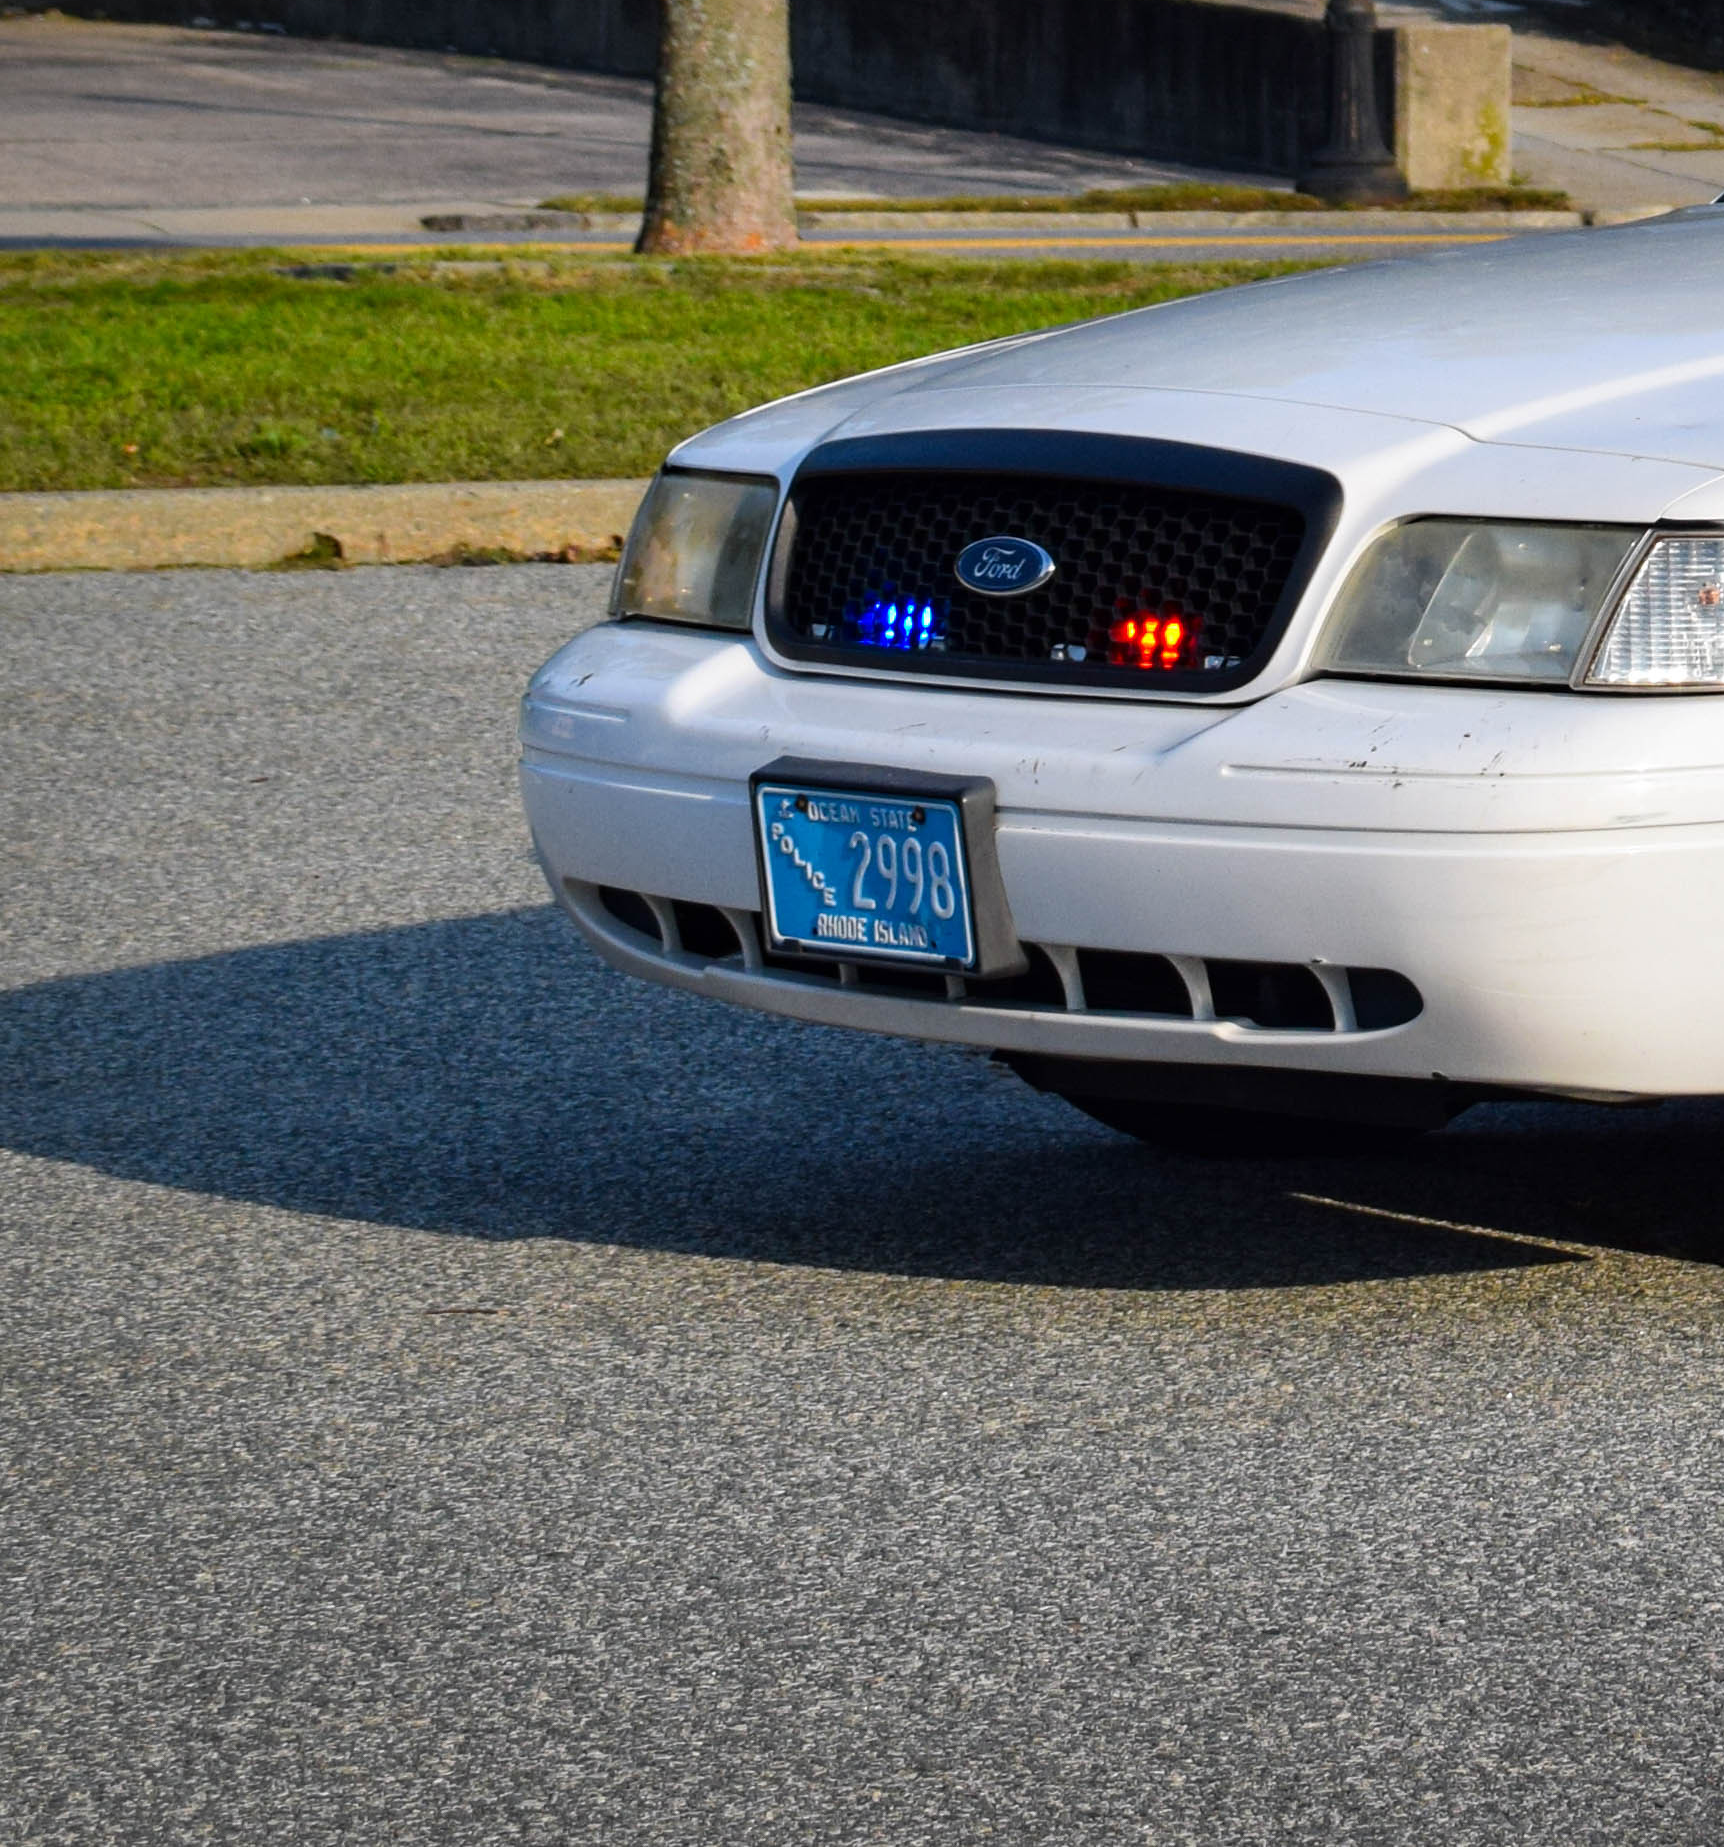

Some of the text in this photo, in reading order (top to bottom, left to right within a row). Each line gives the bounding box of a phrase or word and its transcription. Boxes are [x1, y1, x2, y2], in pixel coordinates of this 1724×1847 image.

[974, 546, 1026, 579] Ford
[807, 801, 917, 832] OCEAN STATE
[770, 822, 837, 906] POLICE
[849, 831, 954, 920] 2998
[817, 913, 927, 948] RHODE ISLAND
